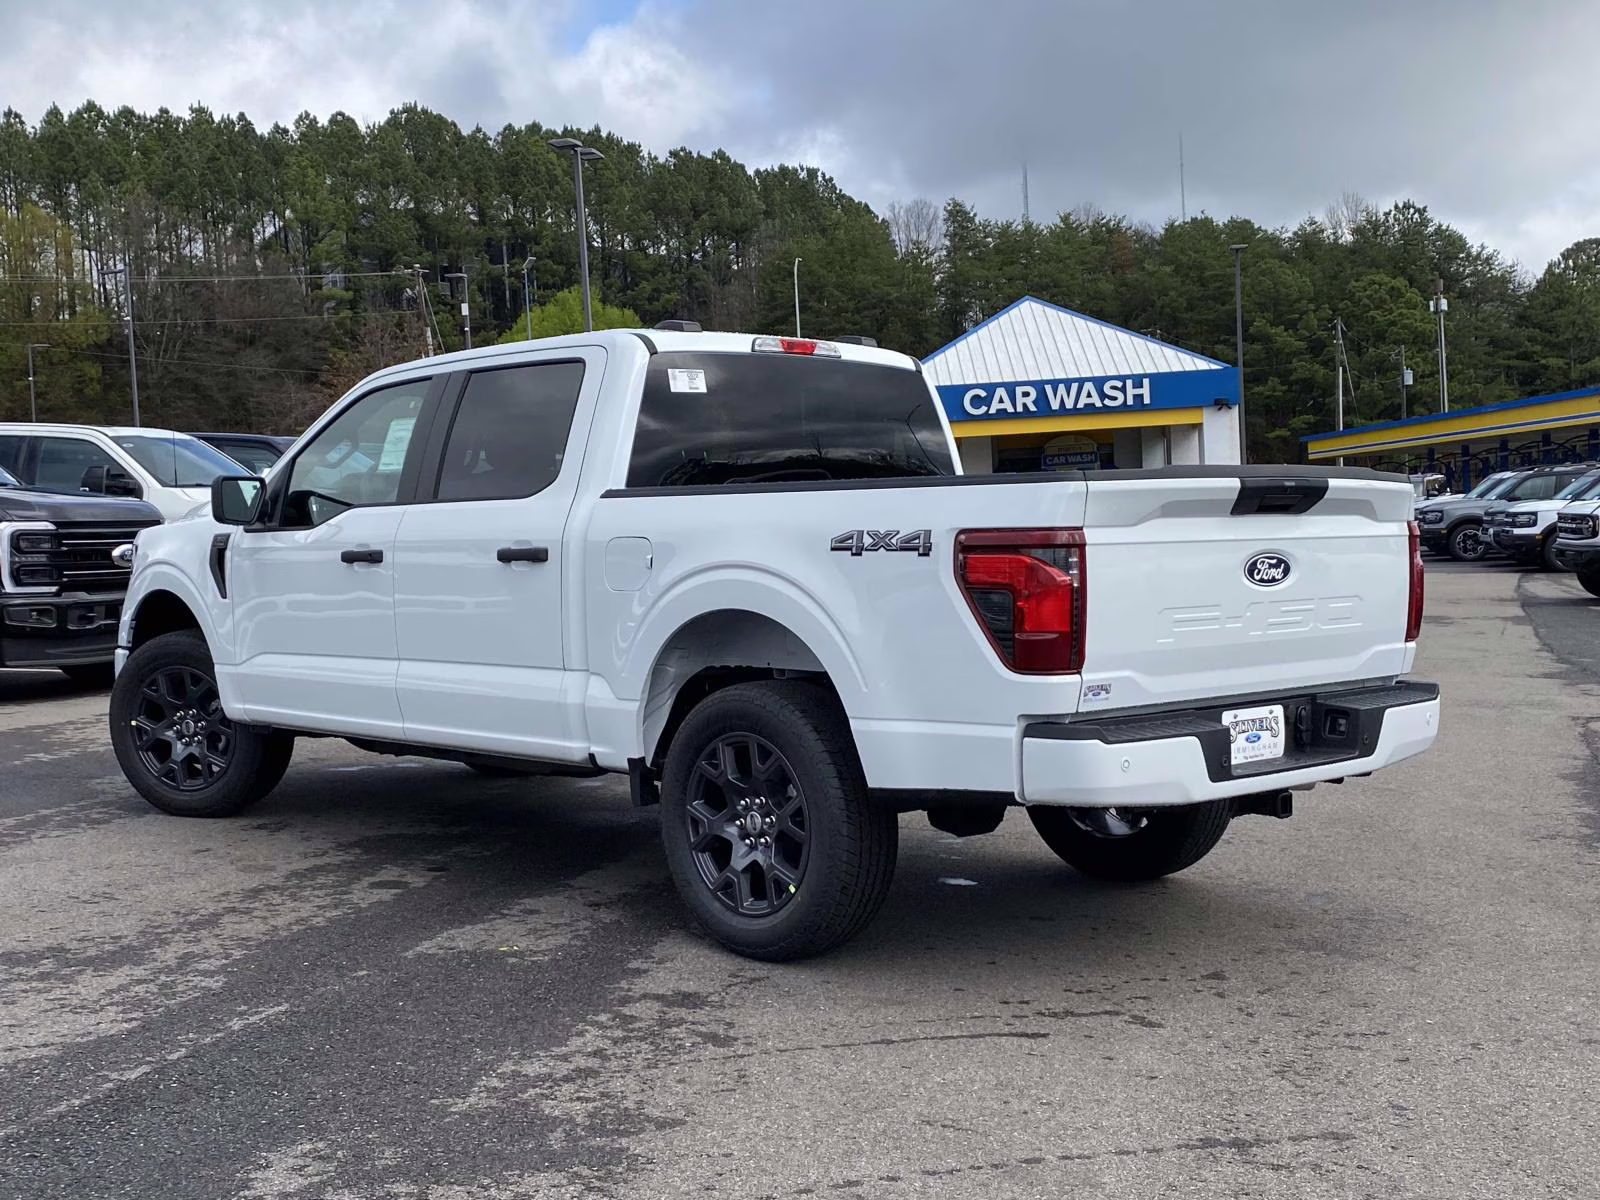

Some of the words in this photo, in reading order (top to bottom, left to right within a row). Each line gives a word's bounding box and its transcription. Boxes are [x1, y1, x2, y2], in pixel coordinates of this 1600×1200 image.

[963, 385, 1037, 416] CAR
[1044, 377, 1151, 411] WASH
[1046, 456, 1066, 465] CAR
[1067, 454, 1095, 463] WASH
[1253, 557, 1285, 581] Ford
[1228, 715, 1280, 743] STIVERS
[1233, 742, 1278, 755] IRMINGHAM
